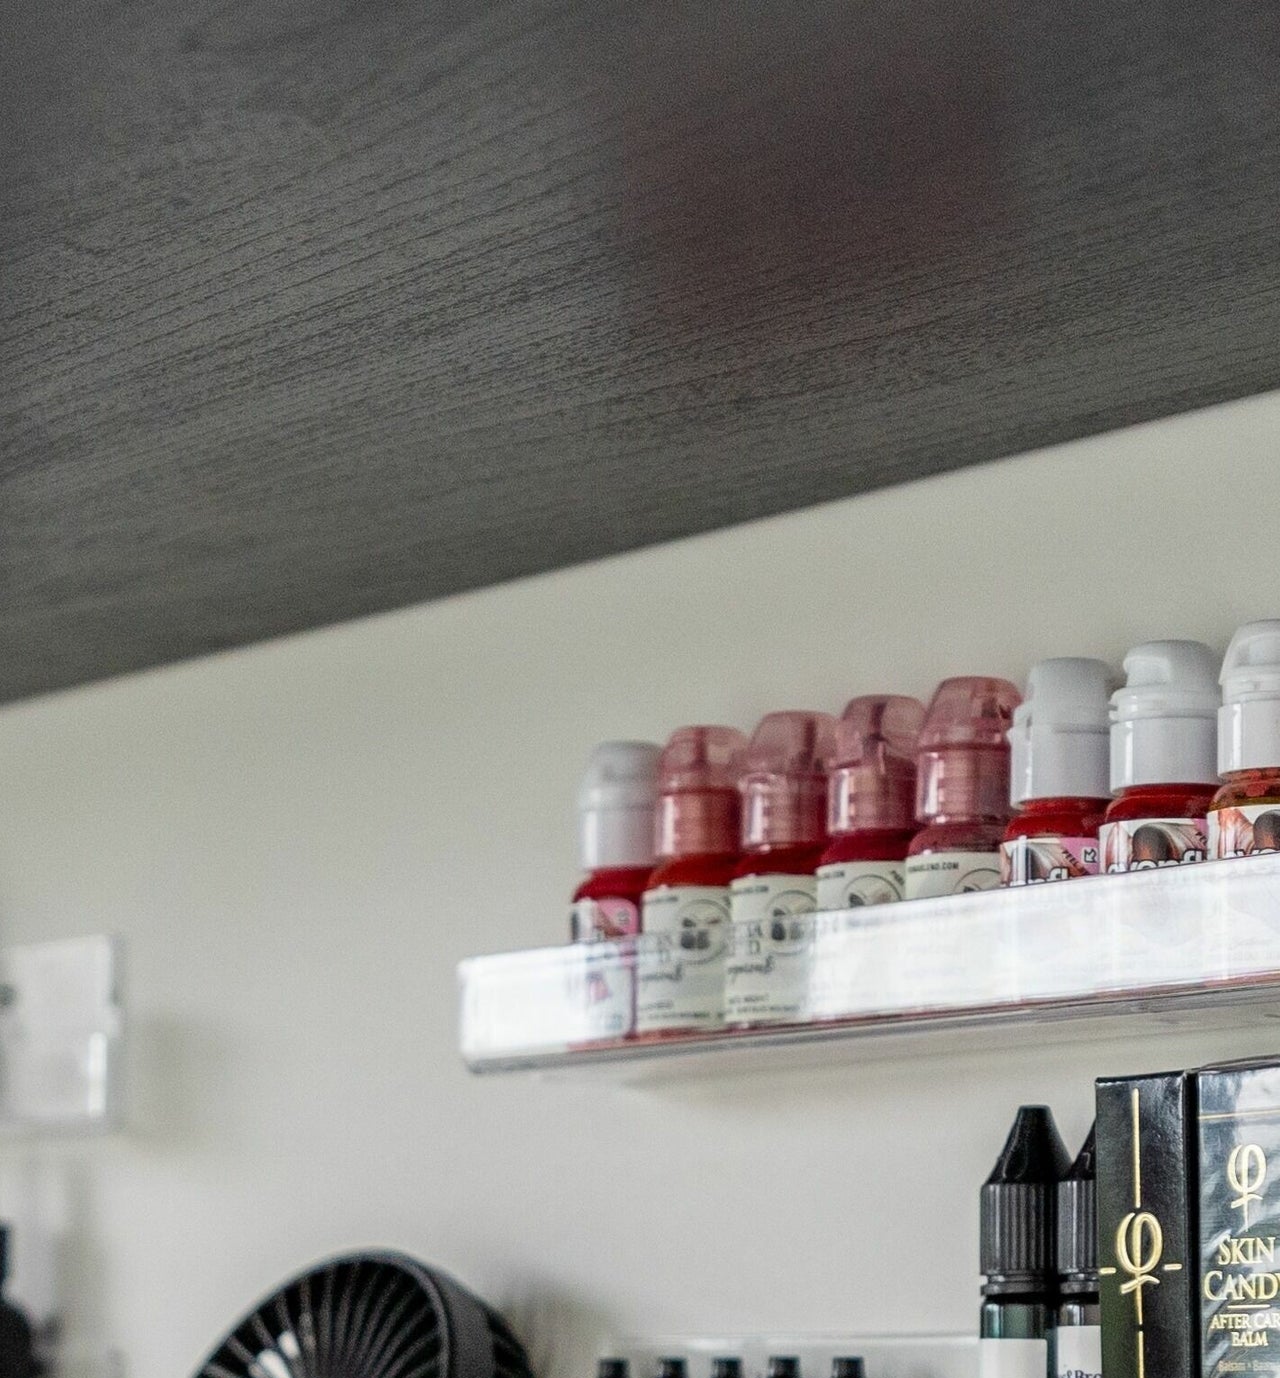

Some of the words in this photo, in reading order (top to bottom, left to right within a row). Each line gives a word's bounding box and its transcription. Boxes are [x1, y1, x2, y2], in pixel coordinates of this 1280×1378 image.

[1218, 1233, 1276, 1266] SKIN
[1210, 1314, 1252, 1329] AFTER
[1231, 1332, 1269, 1347] BALM
